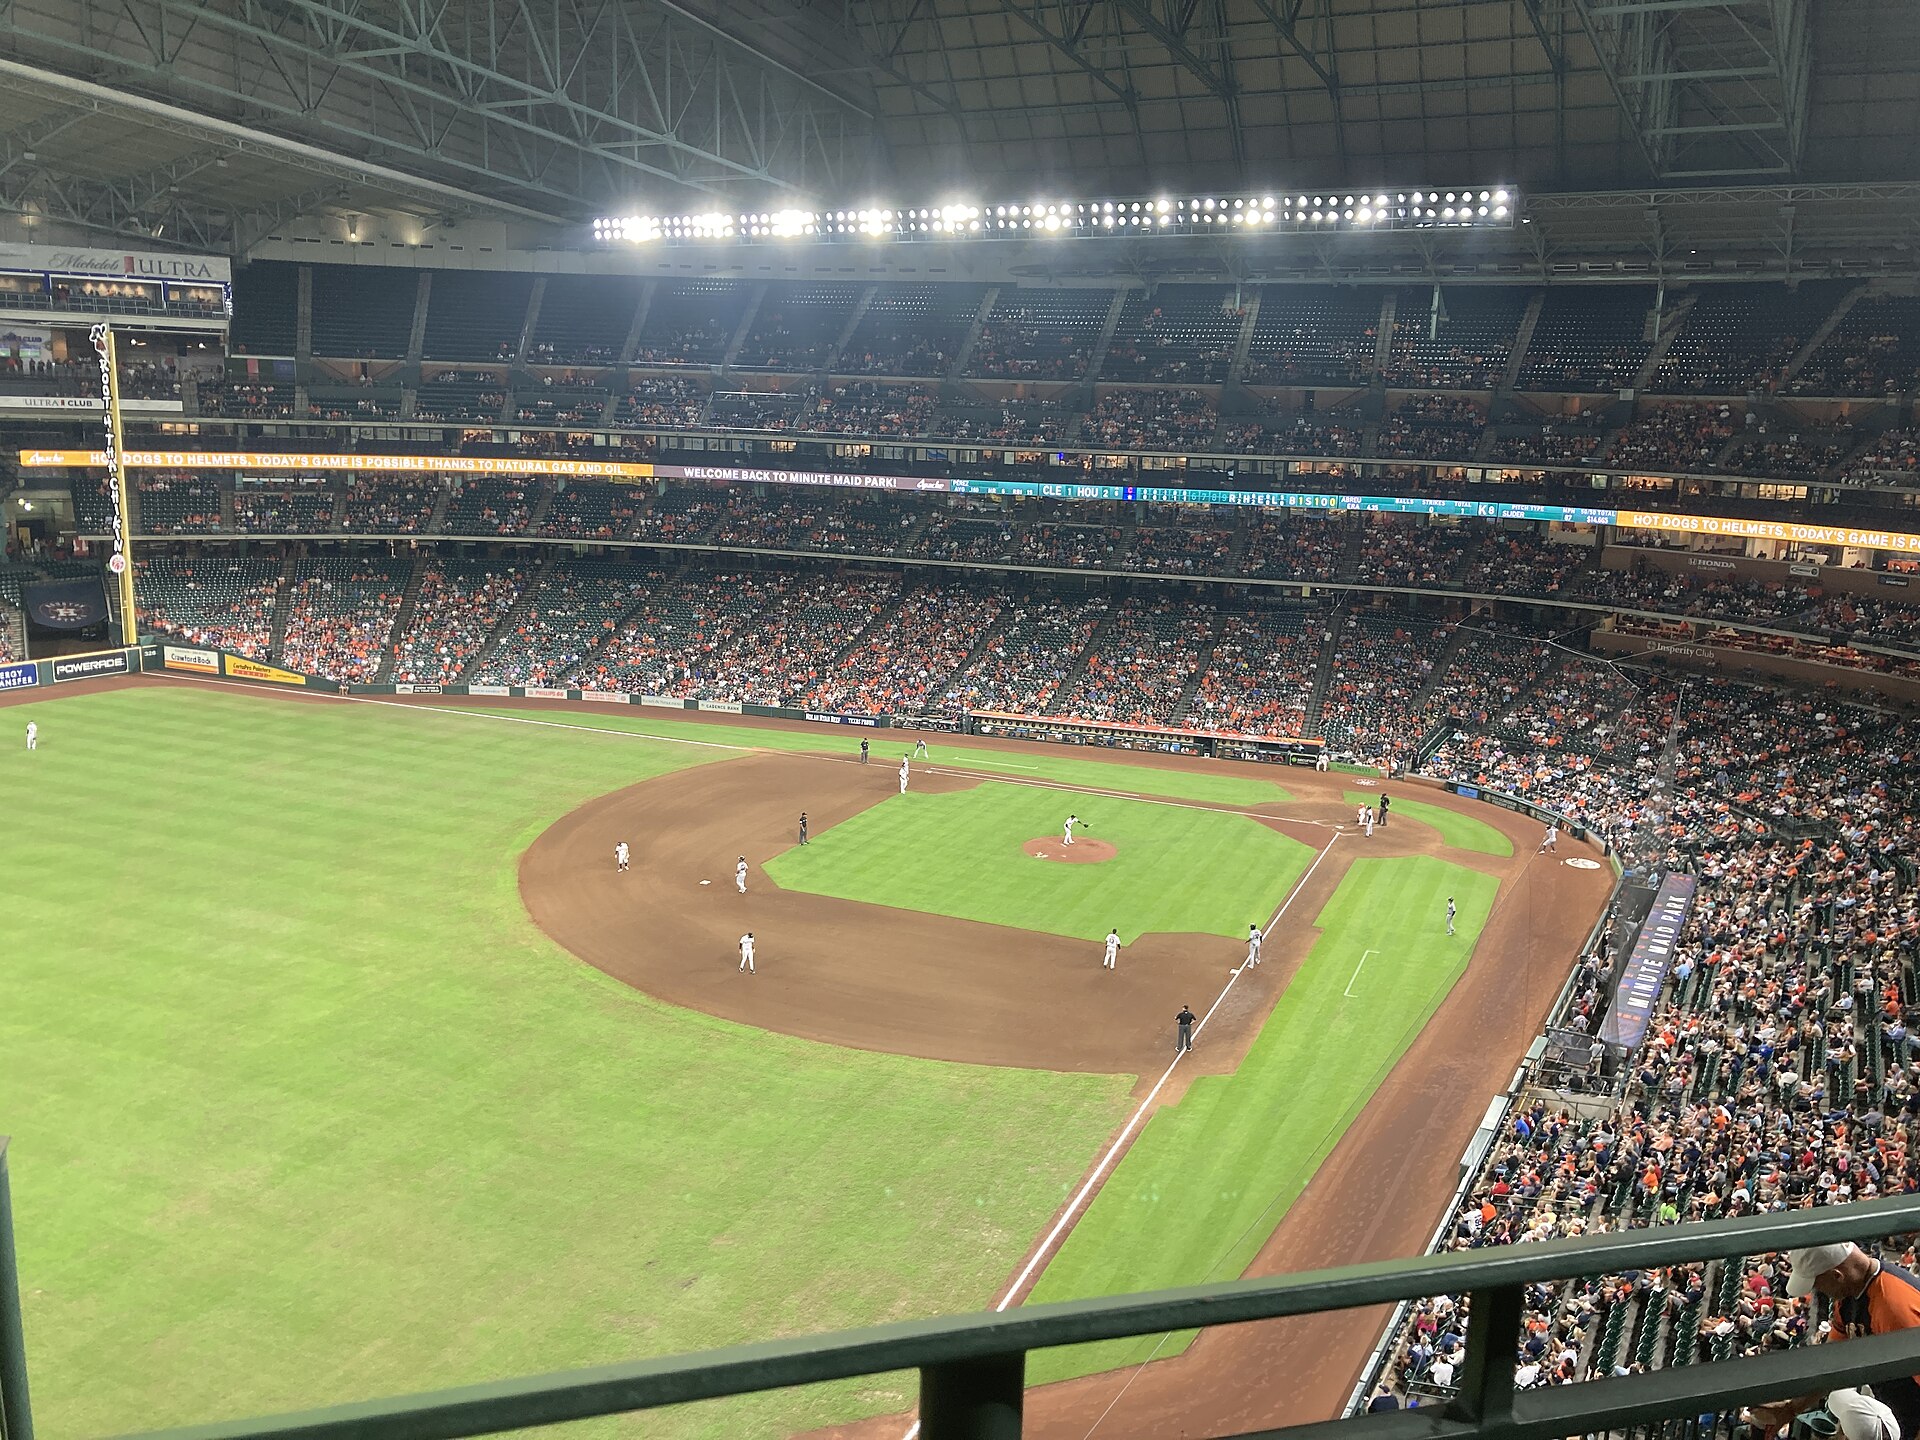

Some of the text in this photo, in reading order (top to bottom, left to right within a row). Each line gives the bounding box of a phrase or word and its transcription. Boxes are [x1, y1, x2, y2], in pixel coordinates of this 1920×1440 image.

[48, 252, 212, 278] Michelob ULTRA
[24, 398, 93, 407] ULTRA CLUB
[99, 358, 112, 410] ROOT
[109, 478, 124, 552] CHIKIN
[122, 454, 162, 464] DOGS
[166, 454, 183, 464] TO
[188, 454, 251, 466] HELMETS,
[255, 456, 308, 466] TODAY'S
[312, 457, 348, 467] GAME
[352, 457, 362, 468] IS
[366, 458, 425, 468] POSSIBLE
[428, 458, 475, 470] THANKS
[478, 460, 492, 470] TO
[496, 460, 549, 472] NATURAL
[552, 462, 575, 472] GAS
[578, 462, 602, 473] AND
[604, 464, 626, 474] OIL.
[684, 468, 739, 480] WELCOME
[742, 470, 770, 481] BACK
[773, 472, 787, 482] TO
[790, 472, 830, 484] MINUTE
[834, 474, 862, 485] MAID
[865, 475, 897, 487] PARK!
[1043, 485, 1061, 495] CLE
[1078, 487, 1098, 497] HOU
[1478, 505, 1486, 515] K
[1633, 515, 1660, 526] HOT
[1662, 516, 1698, 529] DOGS
[1702, 519, 1719, 531] TO
[1721, 521, 1787, 538] HELMETS,
[1791, 527, 1845, 542] TODAY'S
[1848, 532, 1888, 546] GAME
[1892, 536, 1906, 548] IS
[1698, 559, 1736, 569] HONDA
[171, 653, 211, 664] Crawford Bock
[1657, 643, 1715, 658] Insperity Club
[57, 658, 123, 675] POWERADE
[1661, 895, 1687, 922] PARK
[1648, 926, 1676, 955] MAID
[1627, 958, 1664, 1009] MINUTE
